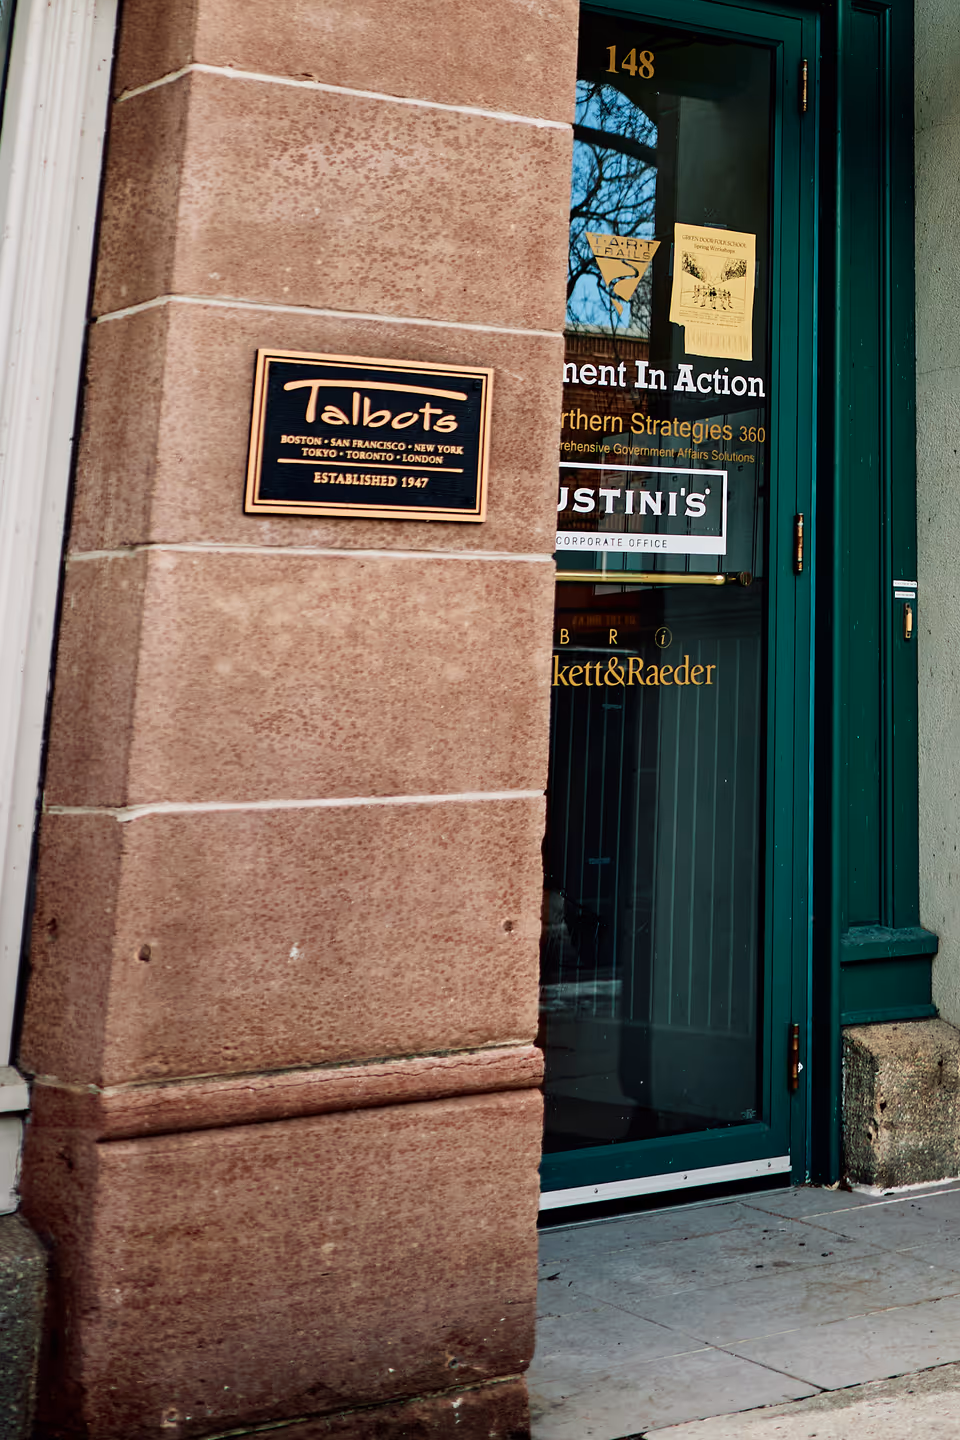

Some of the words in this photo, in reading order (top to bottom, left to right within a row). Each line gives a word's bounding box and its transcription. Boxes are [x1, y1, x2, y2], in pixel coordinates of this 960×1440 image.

[604, 44, 656, 79] 148
[593, 245, 651, 260] TRAILS
[634, 360, 667, 391] In
[673, 363, 766, 398] Action
[283, 378, 468, 433] Talbots
[560, 408, 623, 433] rthern
[630, 412, 733, 444] Strategies
[738, 425, 766, 443] 360
[280, 434, 322, 446] BOSTON
[330, 438, 350, 448] SAN
[352, 439, 406, 451] FRANCISCO
[413, 443, 435, 453] NEW
[437, 444, 464, 455] YORK
[613, 443, 675, 458] Government
[677, 447, 709, 460] Affairs
[711, 449, 755, 463] Solutions
[301, 447, 338, 458] TOKYO
[345, 450, 394, 461] TORONTO
[402, 453, 444, 465] LONDON
[313, 471, 398, 488] ESTABLISHED
[401, 476, 430, 489] 1947
[556, 536, 623, 547] CORPORATE
[628, 538, 668, 549] OFFICE
[559, 628, 570, 645] B
[608, 628, 618, 645] R
[551, 654, 717, 687] kett&Raeder
